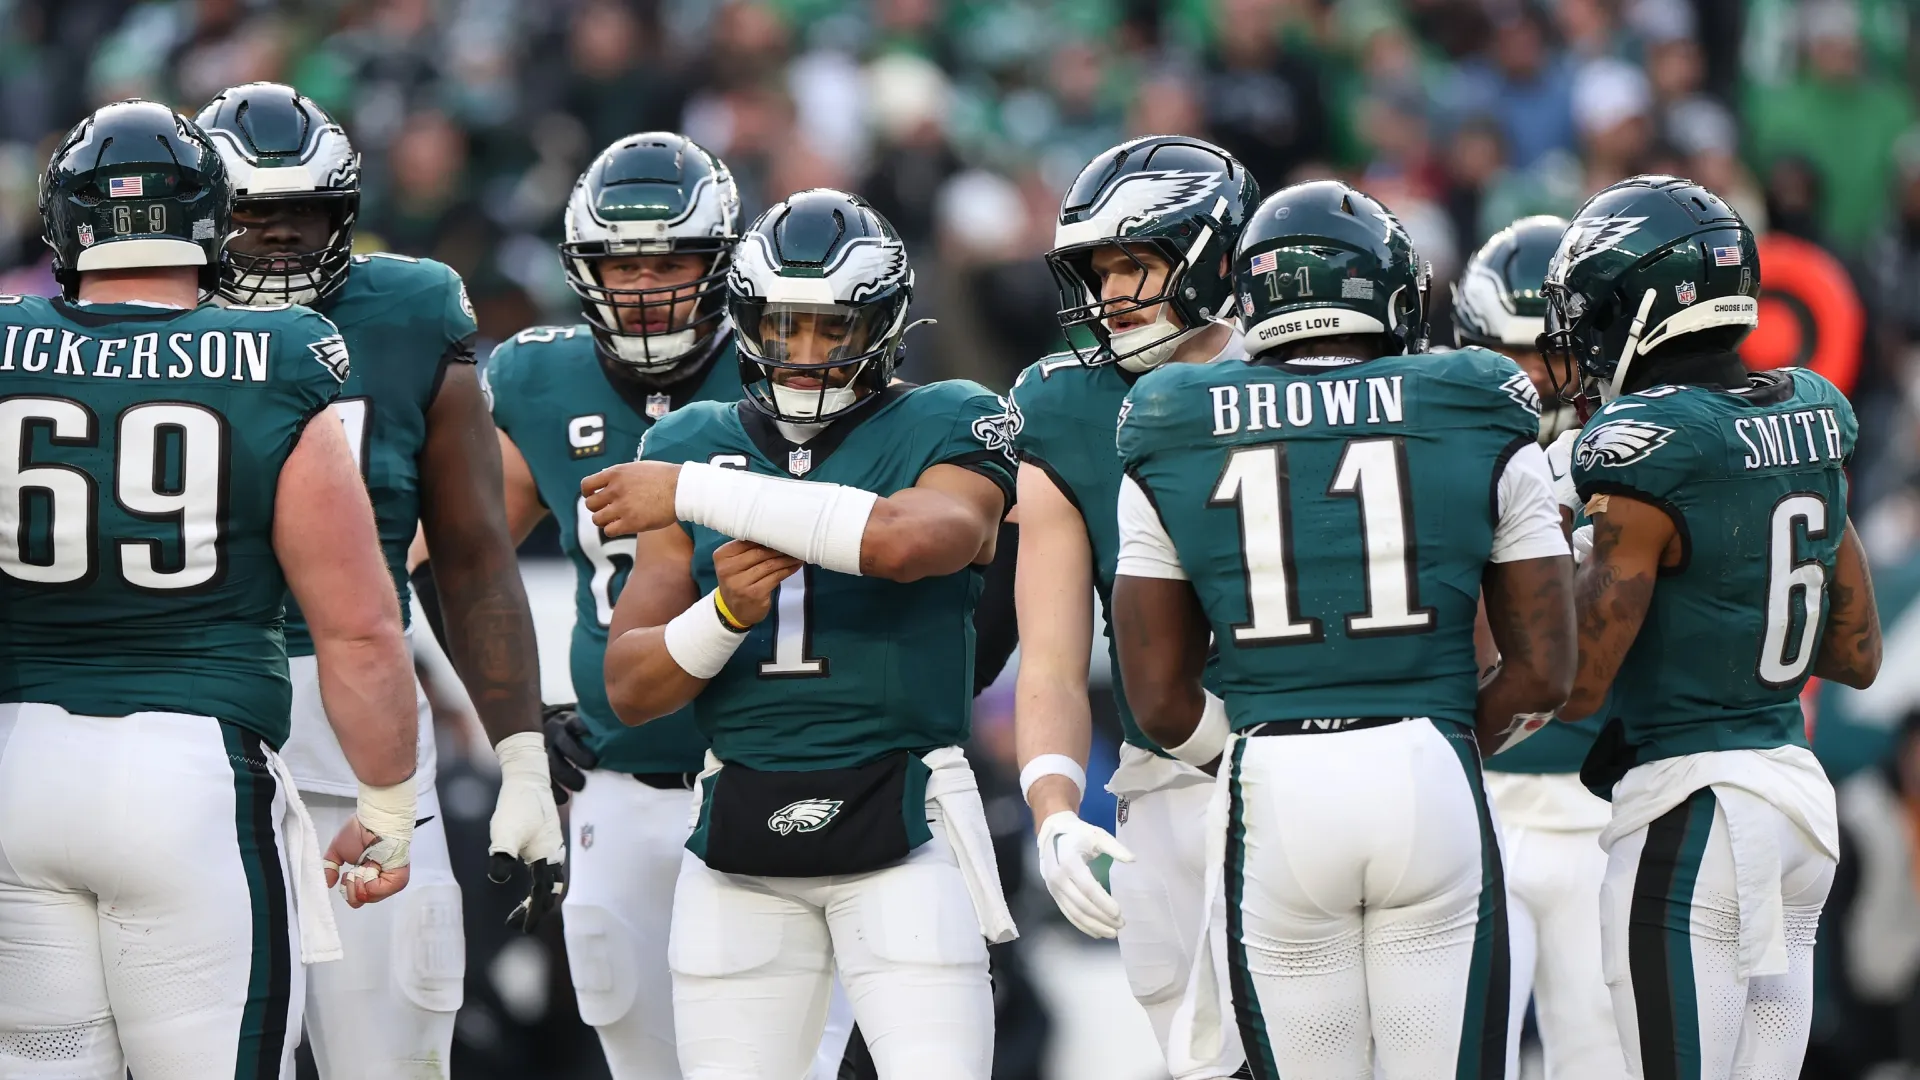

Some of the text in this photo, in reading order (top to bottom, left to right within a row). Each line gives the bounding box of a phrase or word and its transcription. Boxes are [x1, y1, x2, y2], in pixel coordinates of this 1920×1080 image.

[1258, 317, 1340, 340] CHOOSE LOVE
[1714, 304, 1740, 312] CHOOSE
[0, 325, 271, 382] ICKERSON
[568, 414, 604, 448] C
[1208, 375, 1404, 437] BROWN
[1734, 408, 1842, 470] SMITH
[0, 396, 224, 591] 69
[1208, 437, 1433, 643] 11
[759, 561, 824, 675] 1
[1756, 494, 1827, 687] 6
